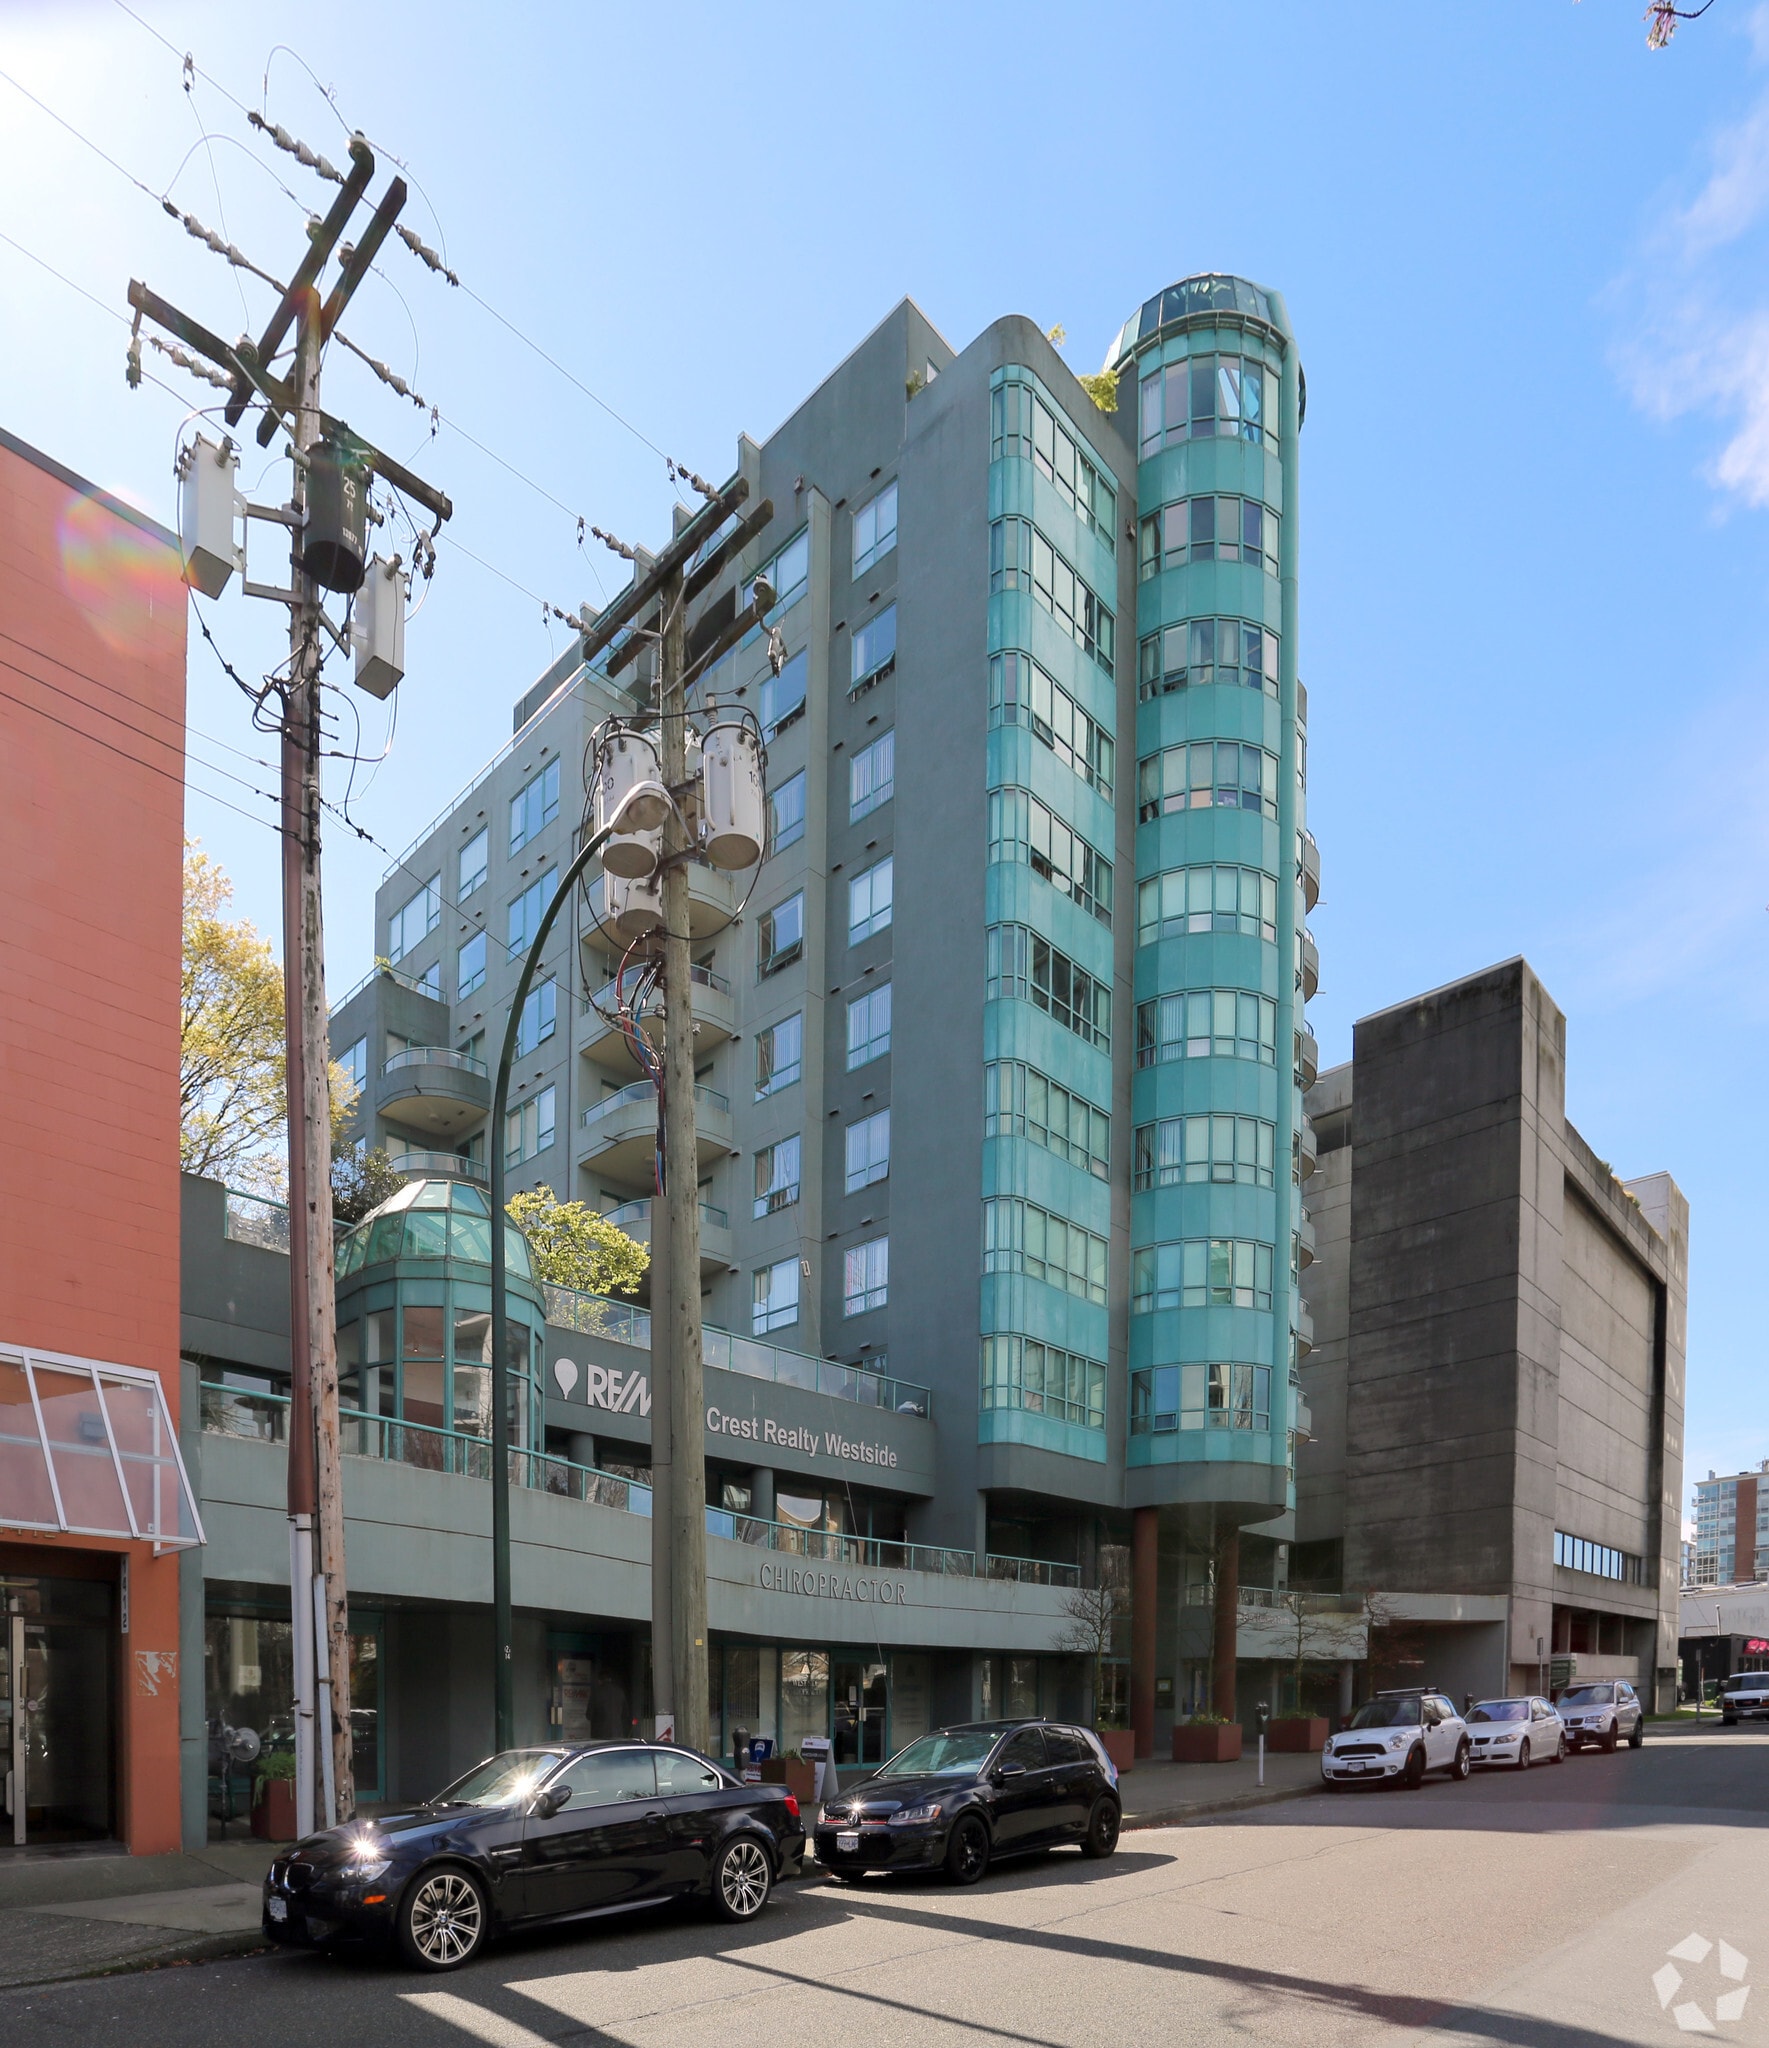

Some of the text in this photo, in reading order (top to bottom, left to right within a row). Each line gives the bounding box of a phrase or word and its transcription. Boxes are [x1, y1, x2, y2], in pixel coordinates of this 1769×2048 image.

[343, 476, 356, 498] 25
[587, 1364, 652, 1417] RE/M
[706, 1406, 898, 1468] Crest Realty Westside
[760, 1562, 906, 1605] CHIROPRACTOR
